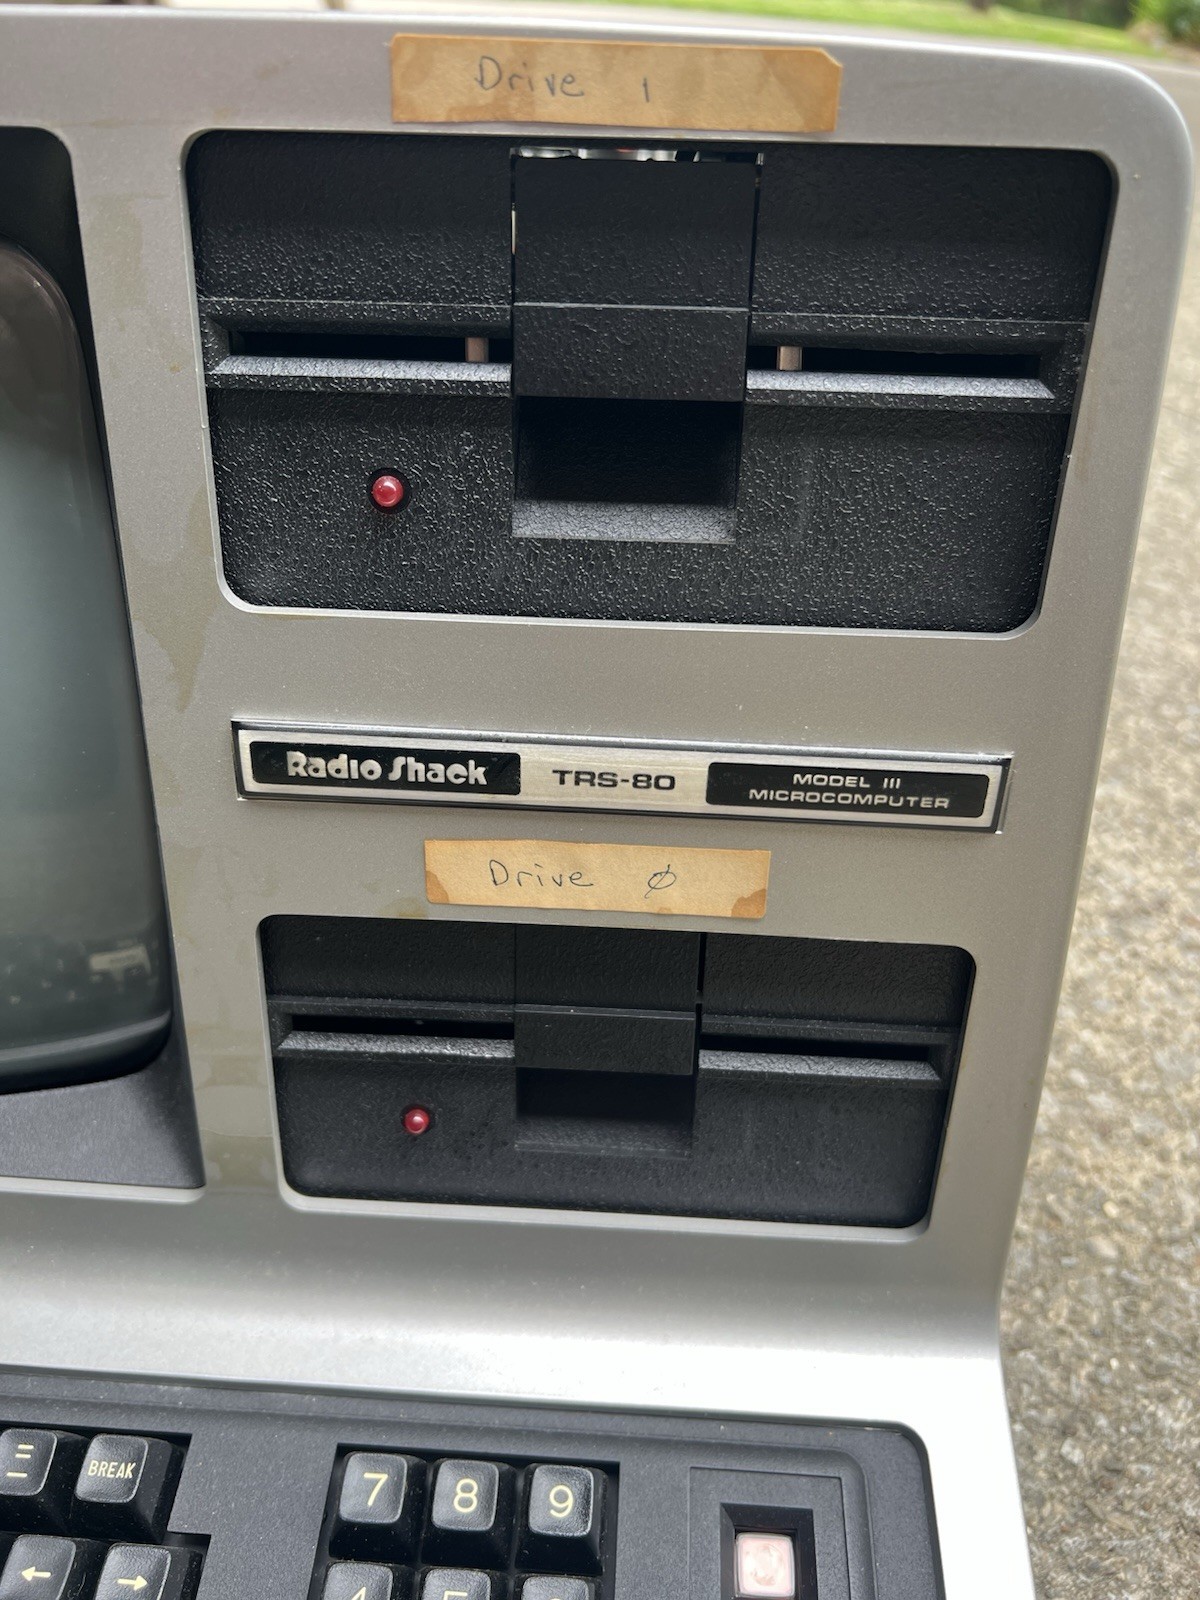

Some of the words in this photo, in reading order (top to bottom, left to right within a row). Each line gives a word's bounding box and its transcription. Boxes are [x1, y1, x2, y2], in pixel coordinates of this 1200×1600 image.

[474, 56, 585, 98] Drive
[643, 77, 650, 103] 1
[286, 750, 382, 781] Radio
[388, 756, 489, 786] Shack
[552, 769, 676, 792] TRS-80
[793, 773, 871, 789] MODEL
[883, 777, 902, 790] III
[749, 788, 950, 809] MICROCOMPUTER
[488, 859, 594, 888] Drive
[87, 1460, 137, 1480] BREAK
[363, 1472, 389, 1507] 7
[453, 1478, 479, 1514] 8
[549, 1484, 574, 1519] 9
